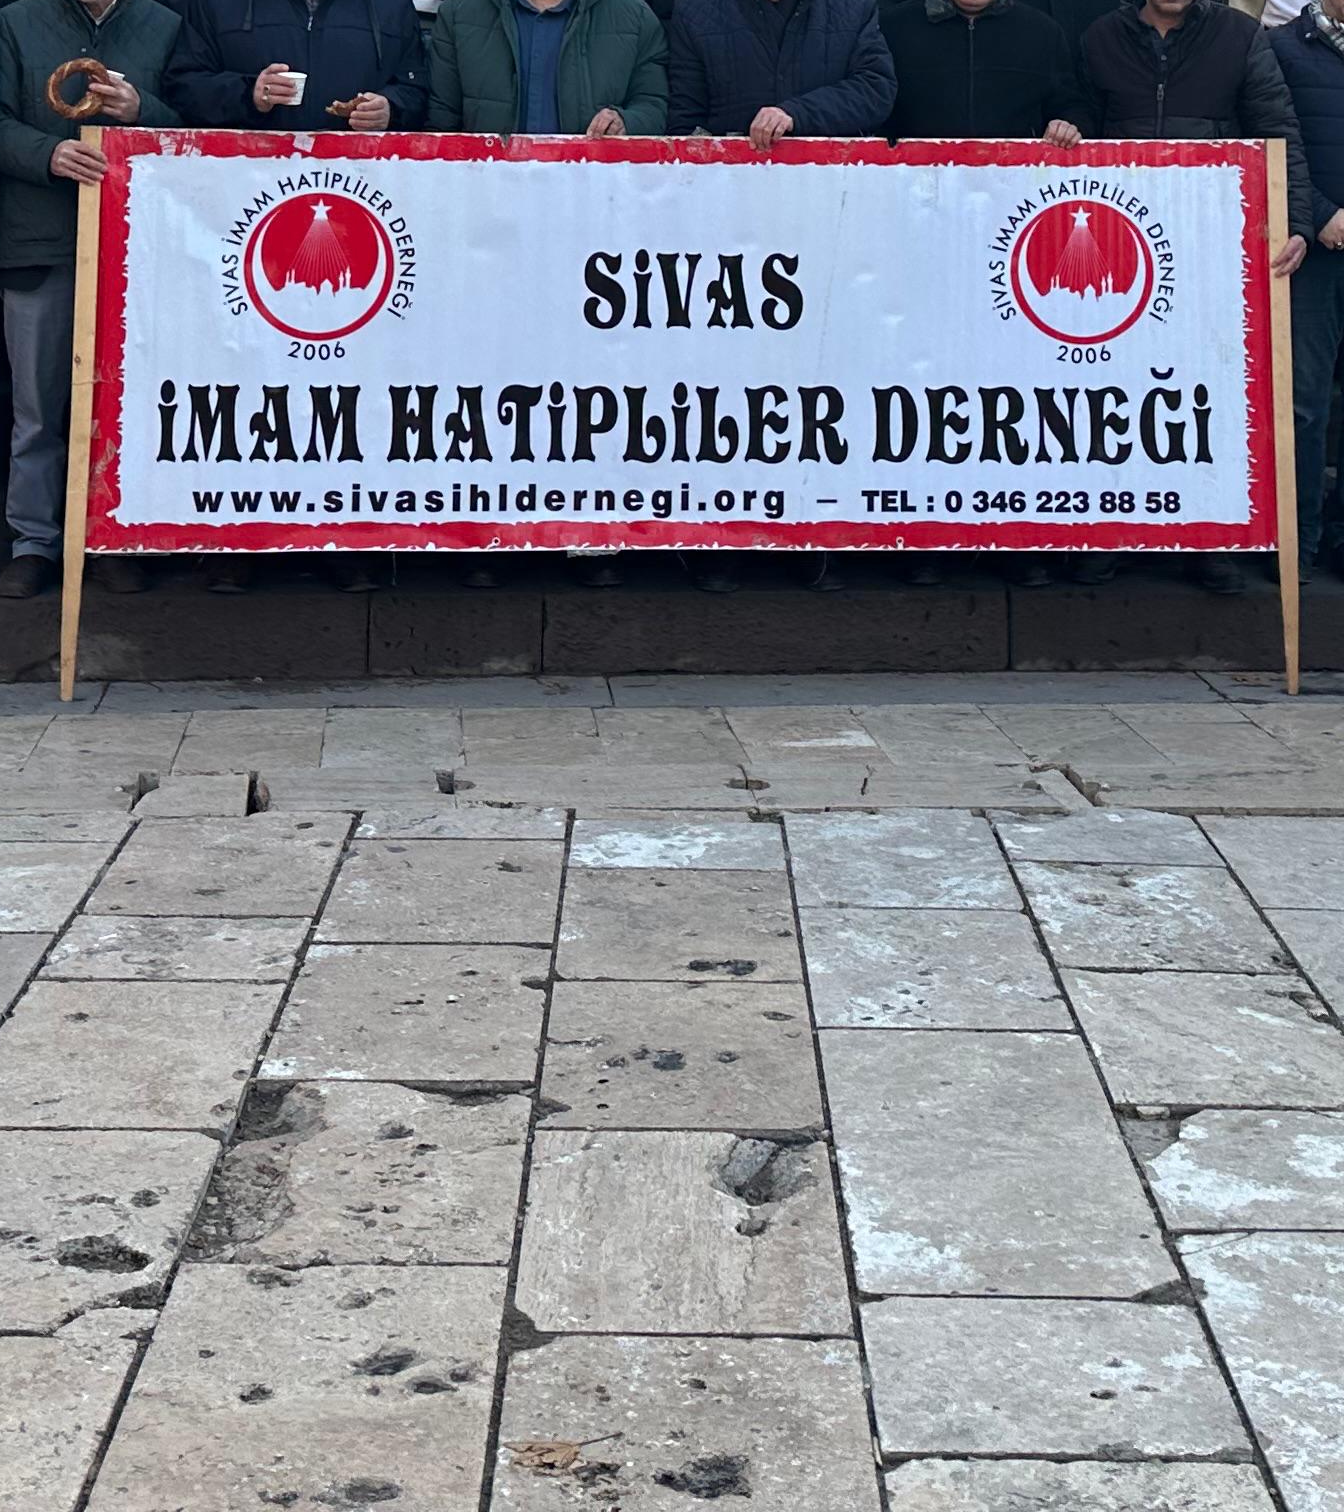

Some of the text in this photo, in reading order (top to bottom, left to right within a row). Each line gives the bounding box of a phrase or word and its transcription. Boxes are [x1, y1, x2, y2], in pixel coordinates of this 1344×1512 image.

[221, 168, 416, 320] SİVAS İMAM HATİPLİLER DERNEĞİ
[987, 175, 1175, 324] SİVAS İMAM HATİPLİLER DERNEĞİ
[287, 341, 346, 361] 2006
[1056, 345, 1112, 364] 2006
[192, 483, 785, 519] www.sivasihldernegi.org
[945, 490, 963, 513] 0
[972, 490, 1027, 513] 346
[1036, 490, 1090, 513] 223
[1099, 490, 1136, 513] 88
[1144, 490, 1181, 513] 58
